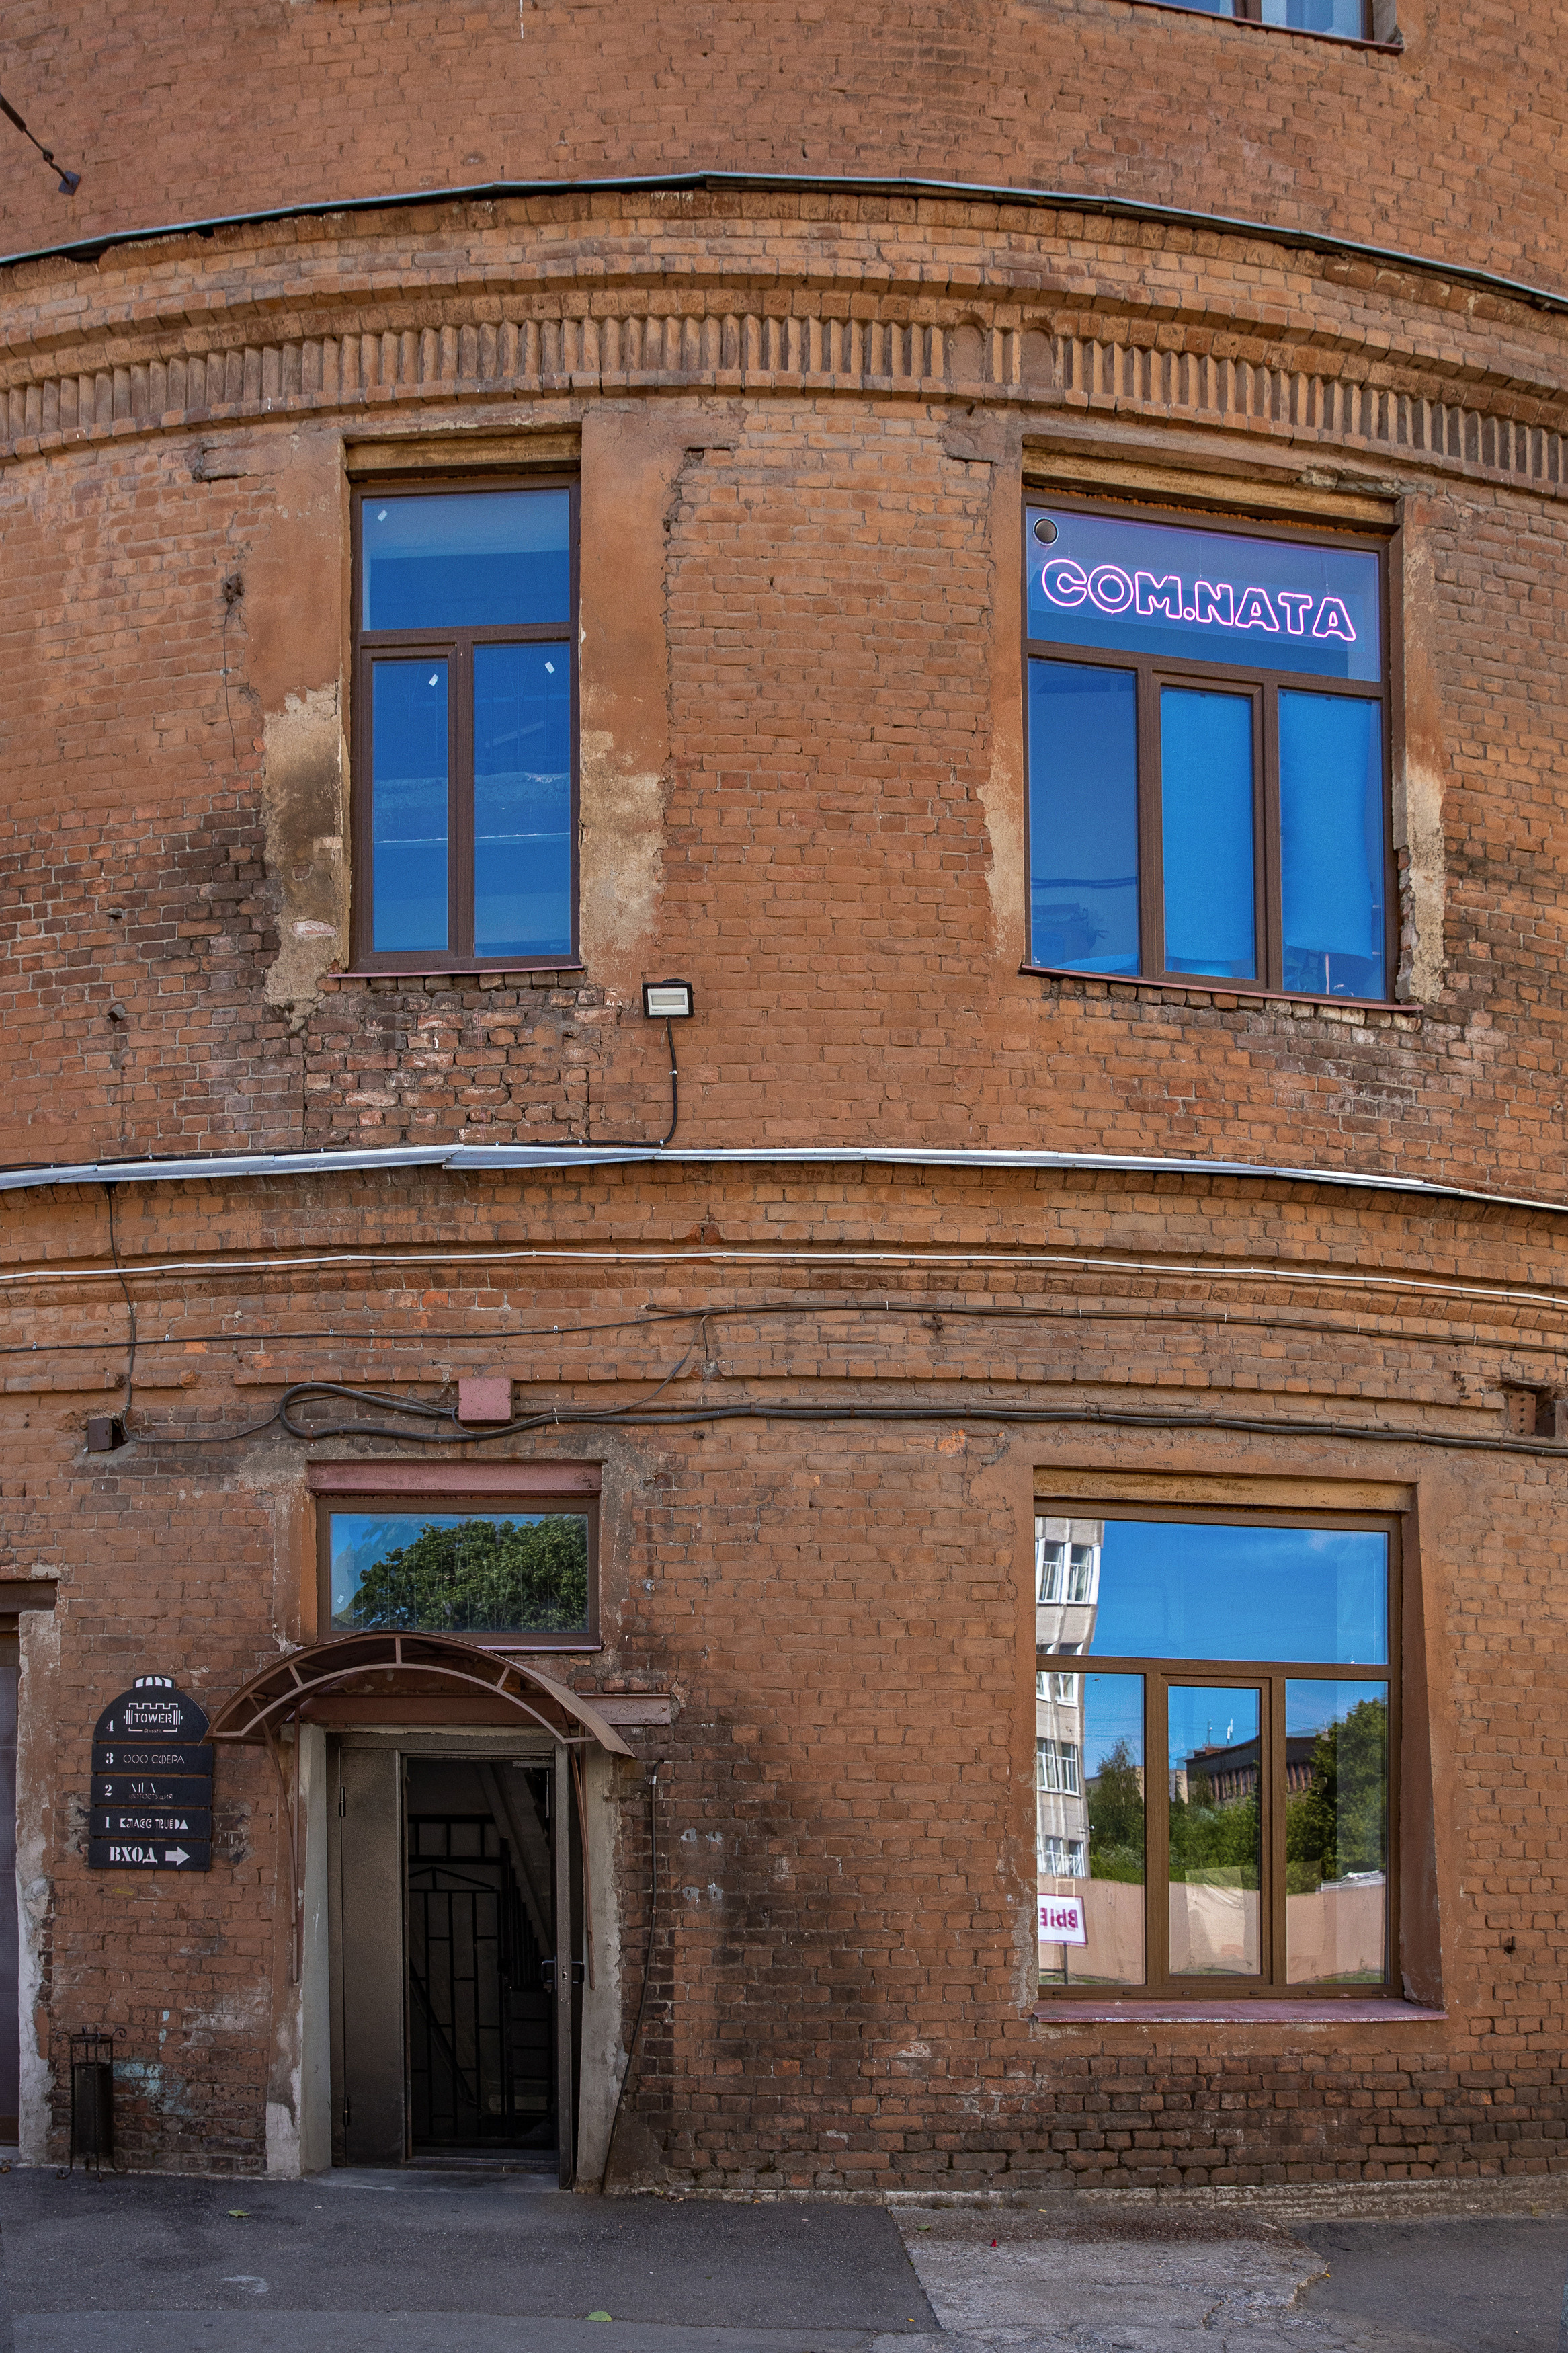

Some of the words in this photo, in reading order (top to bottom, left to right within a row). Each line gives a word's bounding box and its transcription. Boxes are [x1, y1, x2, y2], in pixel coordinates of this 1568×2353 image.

[1041, 558, 1357, 641] COM.NATA
[134, 1713, 172, 1723] TOWER
[106, 1720, 114, 1732] 4
[106, 1752, 114, 1764] 3
[123, 1754, 149, 1763] ООО
[151, 1755, 185, 1764] СФЕРА
[104, 1784, 112, 1796] 2
[105, 1816, 110, 1828] 1
[120, 1818, 152, 1829] КЛАСС
[109, 1846, 158, 1864] ВХОД
